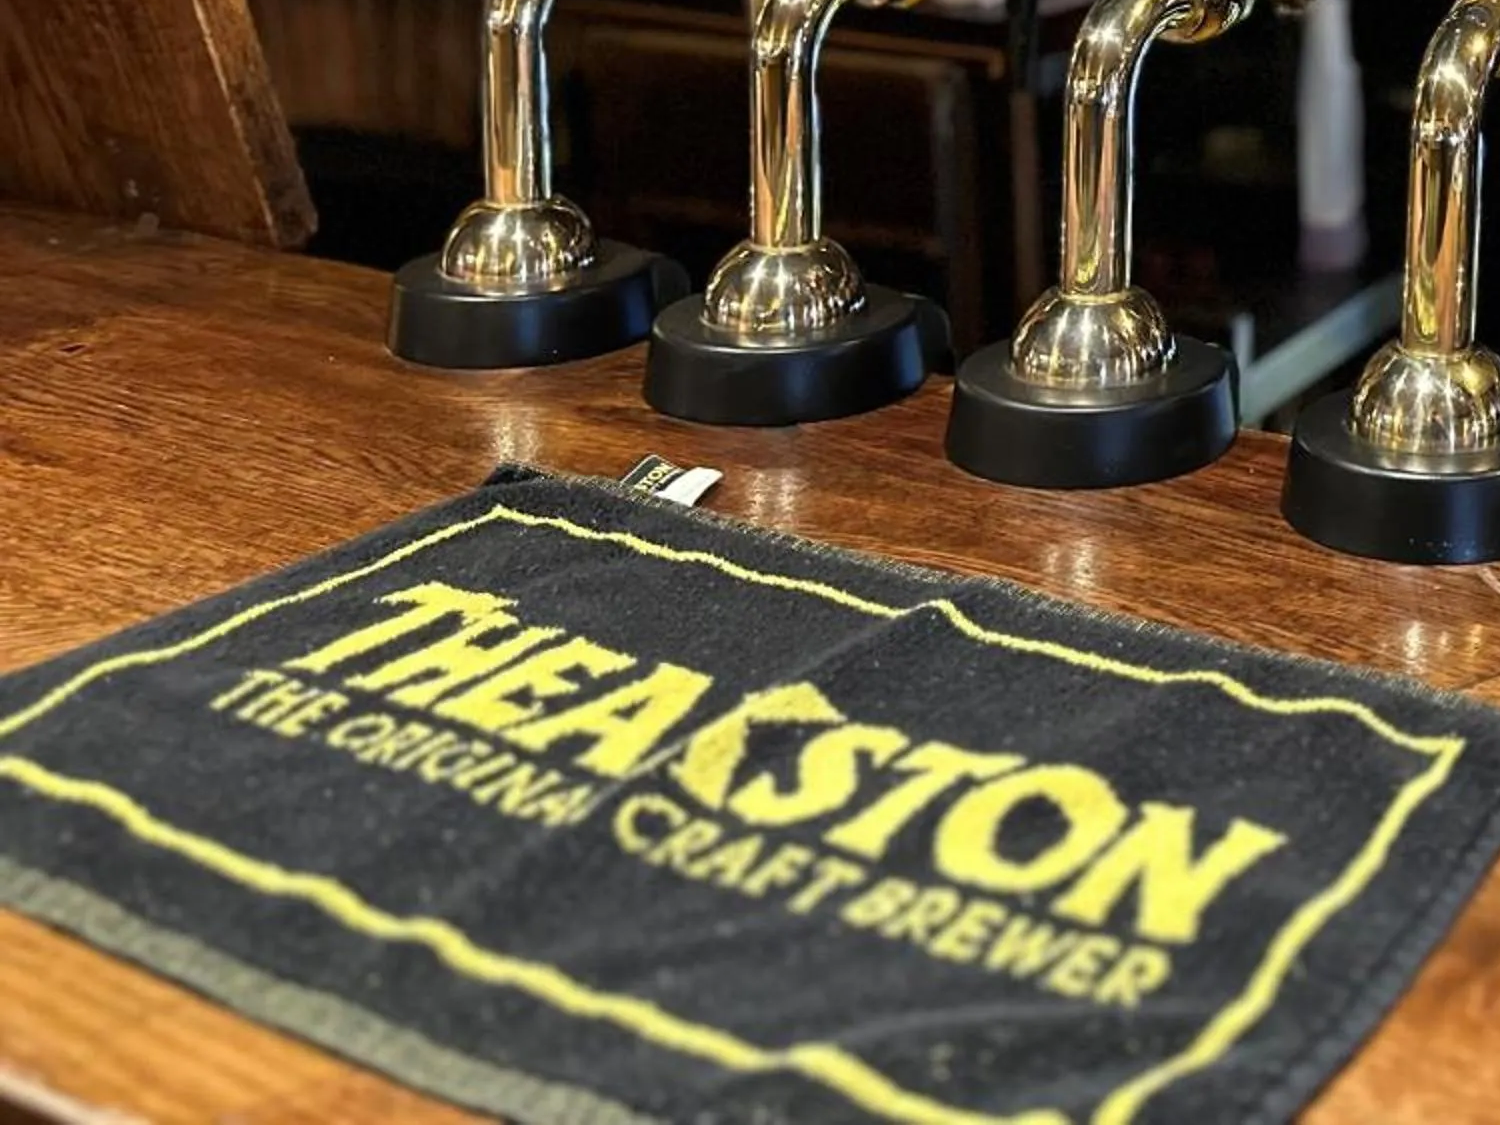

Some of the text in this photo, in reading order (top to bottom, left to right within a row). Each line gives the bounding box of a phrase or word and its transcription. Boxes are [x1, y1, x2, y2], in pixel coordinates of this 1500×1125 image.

[208, 669, 1172, 1008] THE ORIGINA CRAFT BREWER
